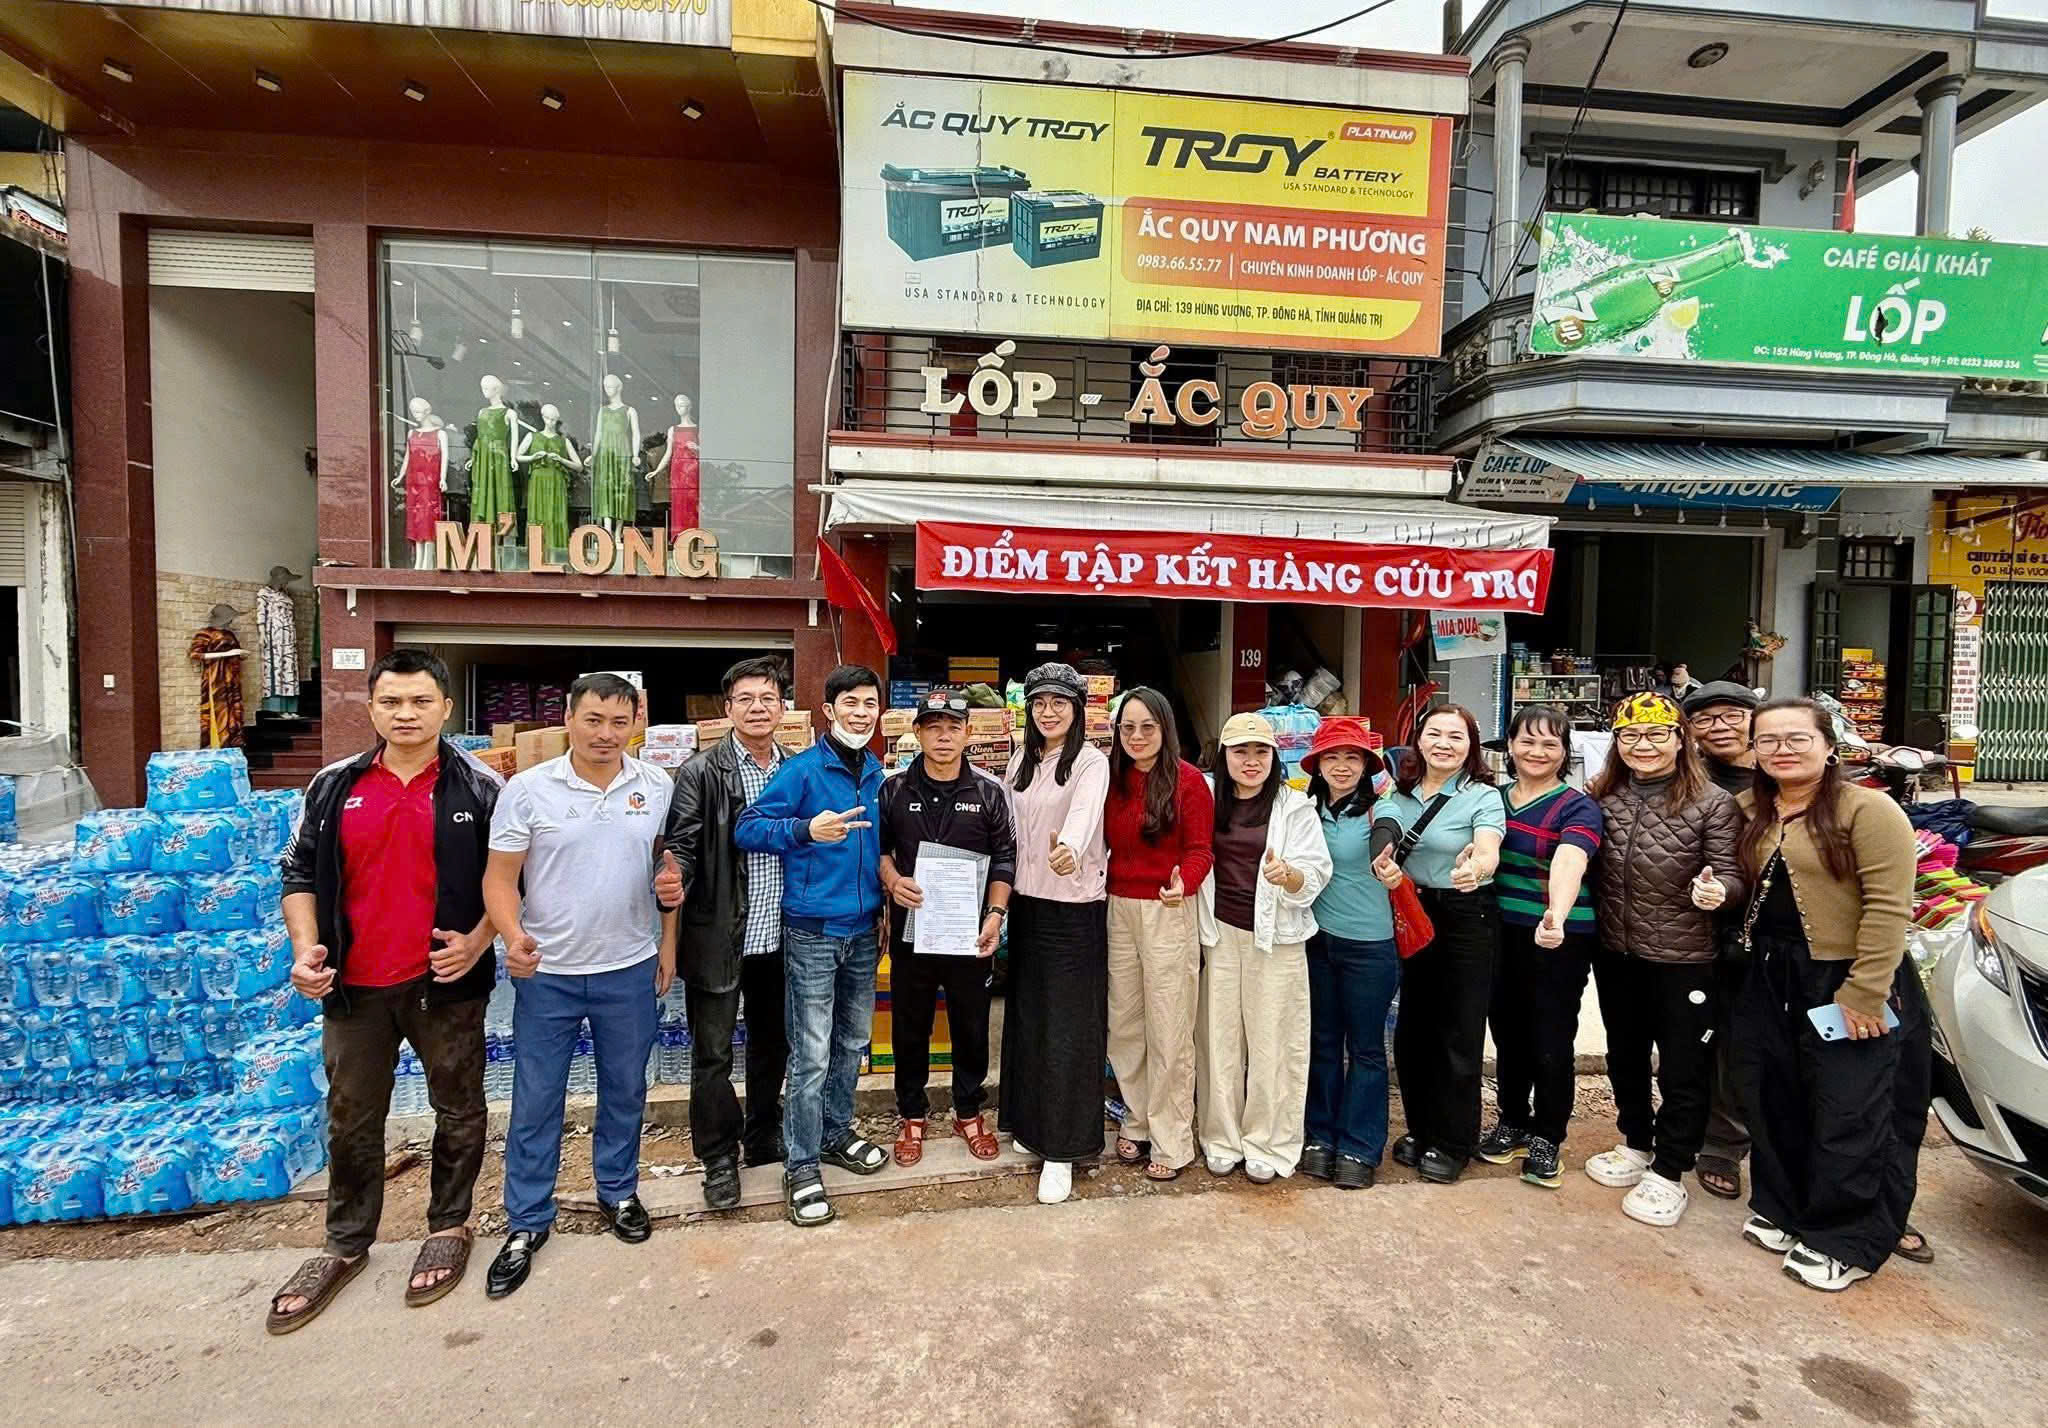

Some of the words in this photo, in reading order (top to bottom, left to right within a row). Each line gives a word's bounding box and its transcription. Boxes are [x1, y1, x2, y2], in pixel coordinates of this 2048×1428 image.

[880, 101, 936, 130] ẮC
[941, 112, 1023, 136] QUY
[1025, 117, 1111, 142] TROY
[1347, 126, 1415, 141] PLATINUM
[1141, 126, 1328, 177] TROY
[1283, 182, 1301, 191] USA
[1303, 183, 1348, 194] STANDARD
[1358, 187, 1415, 199] TECHNOLOGY
[1314, 167, 1403, 184] BATTERY
[945, 201, 991, 220] TROY
[1043, 223, 1080, 234] TROY
[1137, 208, 1174, 239] ẮC
[1180, 217, 1239, 244] QUY
[1244, 221, 1306, 249] NAM
[1312, 226, 1427, 256] PHƯƠNG
[1137, 254, 1223, 273] 0983.66.55.77
[1240, 260, 1284, 277] CHUYÊN
[1287, 263, 1314, 278] KINH
[1316, 265, 1355, 281] DOANH
[1357, 264, 1378, 282] LỐP
[1401, 271, 1425, 286] QUY
[1823, 244, 1879, 270] CAFÉ
[1883, 245, 1930, 274] GIẢI
[1935, 251, 1993, 278] KHÁT
[904, 287, 929, 299] USA
[1011, 293, 1018, 304] &
[1025, 294, 1106, 309] TECHNOLOGY
[1136, 298, 1152, 312] ĐỊA
[1176, 302, 1193, 313] 139
[1195, 300, 1219, 316] HÙNG
[1256, 307, 1270, 319] TP.
[1272, 305, 1297, 321] ĐÔNG
[1338, 308, 1367, 326] QUẢNG
[1369, 313, 1383, 329] TRỊ
[1842, 277, 1948, 346] LỐP
[1773, 347, 1788, 357] 152
[921, 340, 1056, 418] LỐP
[1124, 345, 1221, 426] ẮC
[1240, 382, 1375, 439] QUY
[942, 529, 1049, 580] ĐIỂM
[1060, 543, 1144, 592] TẬP
[1155, 541, 1237, 587] KẾT
[1248, 551, 1363, 594] HÀNG
[1374, 559, 1454, 599] CỨU
[1240, 648, 1262, 668] 139
